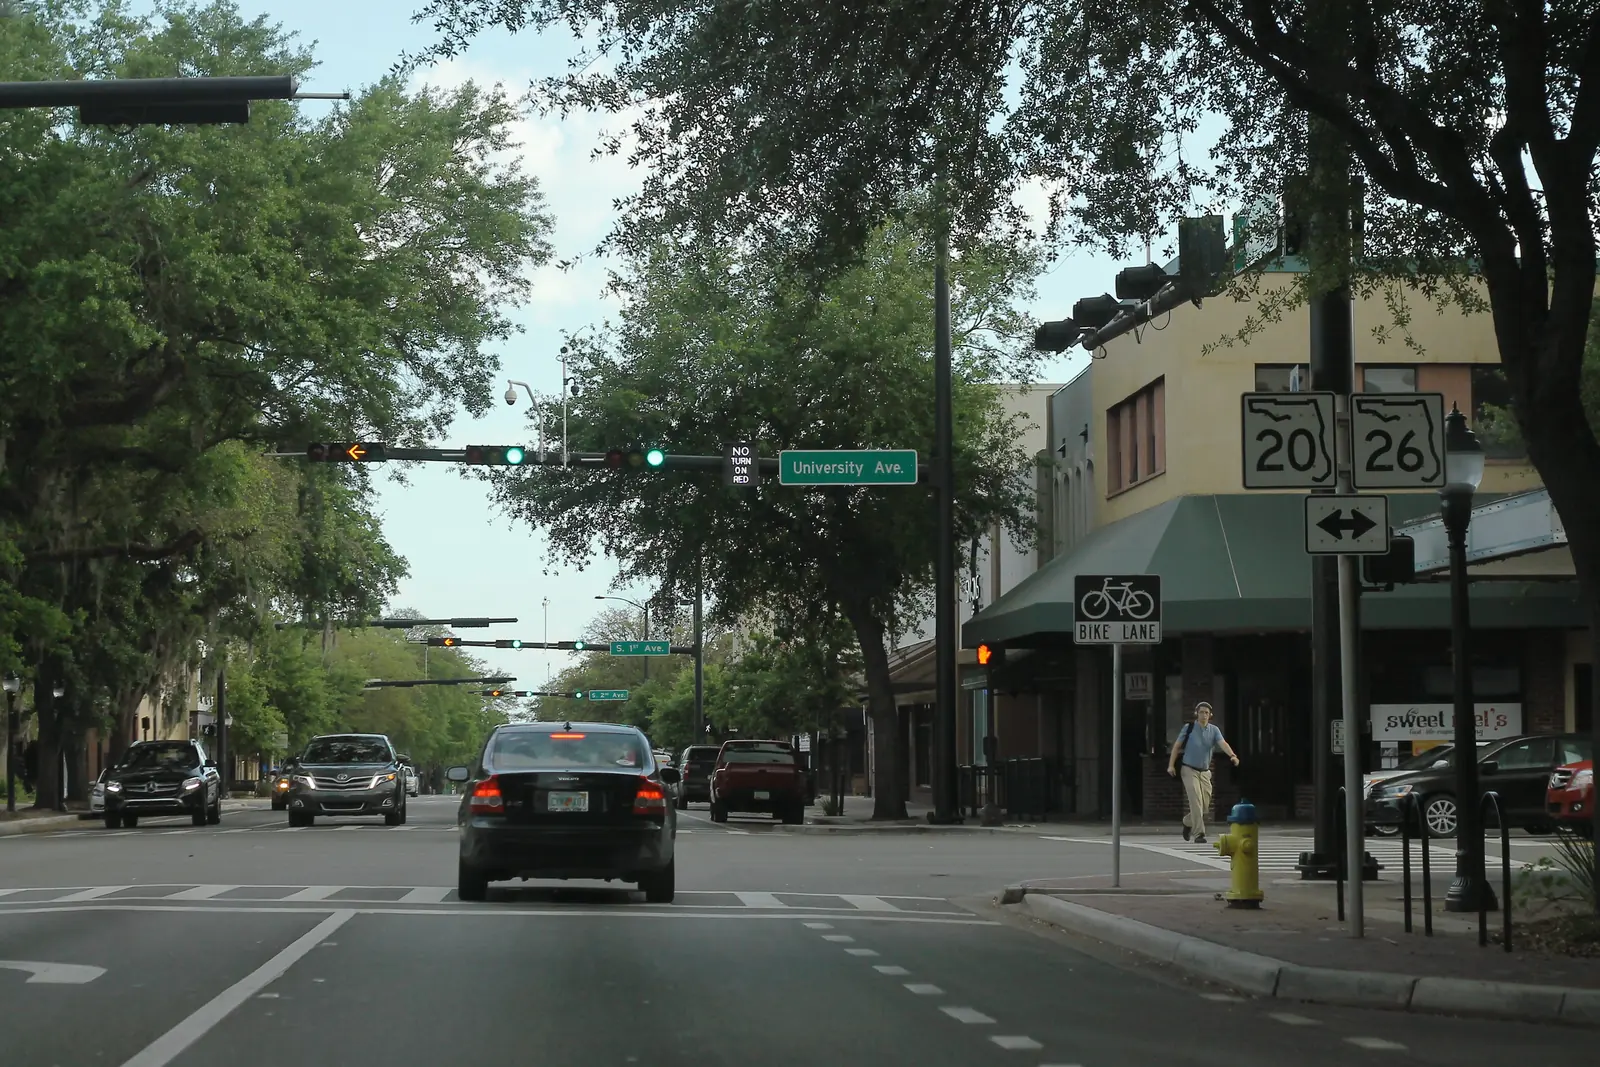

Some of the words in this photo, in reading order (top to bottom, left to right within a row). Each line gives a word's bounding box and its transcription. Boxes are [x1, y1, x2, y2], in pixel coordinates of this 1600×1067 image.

[732, 446, 750, 456] NO
[1255, 428, 1316, 472] 20
[1365, 428, 1425, 472] 26
[731, 457, 751, 465] TURN
[735, 466, 748, 474] ON
[793, 460, 864, 477] University
[874, 461, 904, 474] Ave.
[733, 475, 749, 484] RED
[1079, 624, 1110, 640] BIKE
[1122, 624, 1156, 640] LANE
[616, 644, 625, 652] S.
[644, 644, 664, 652] Ave.
